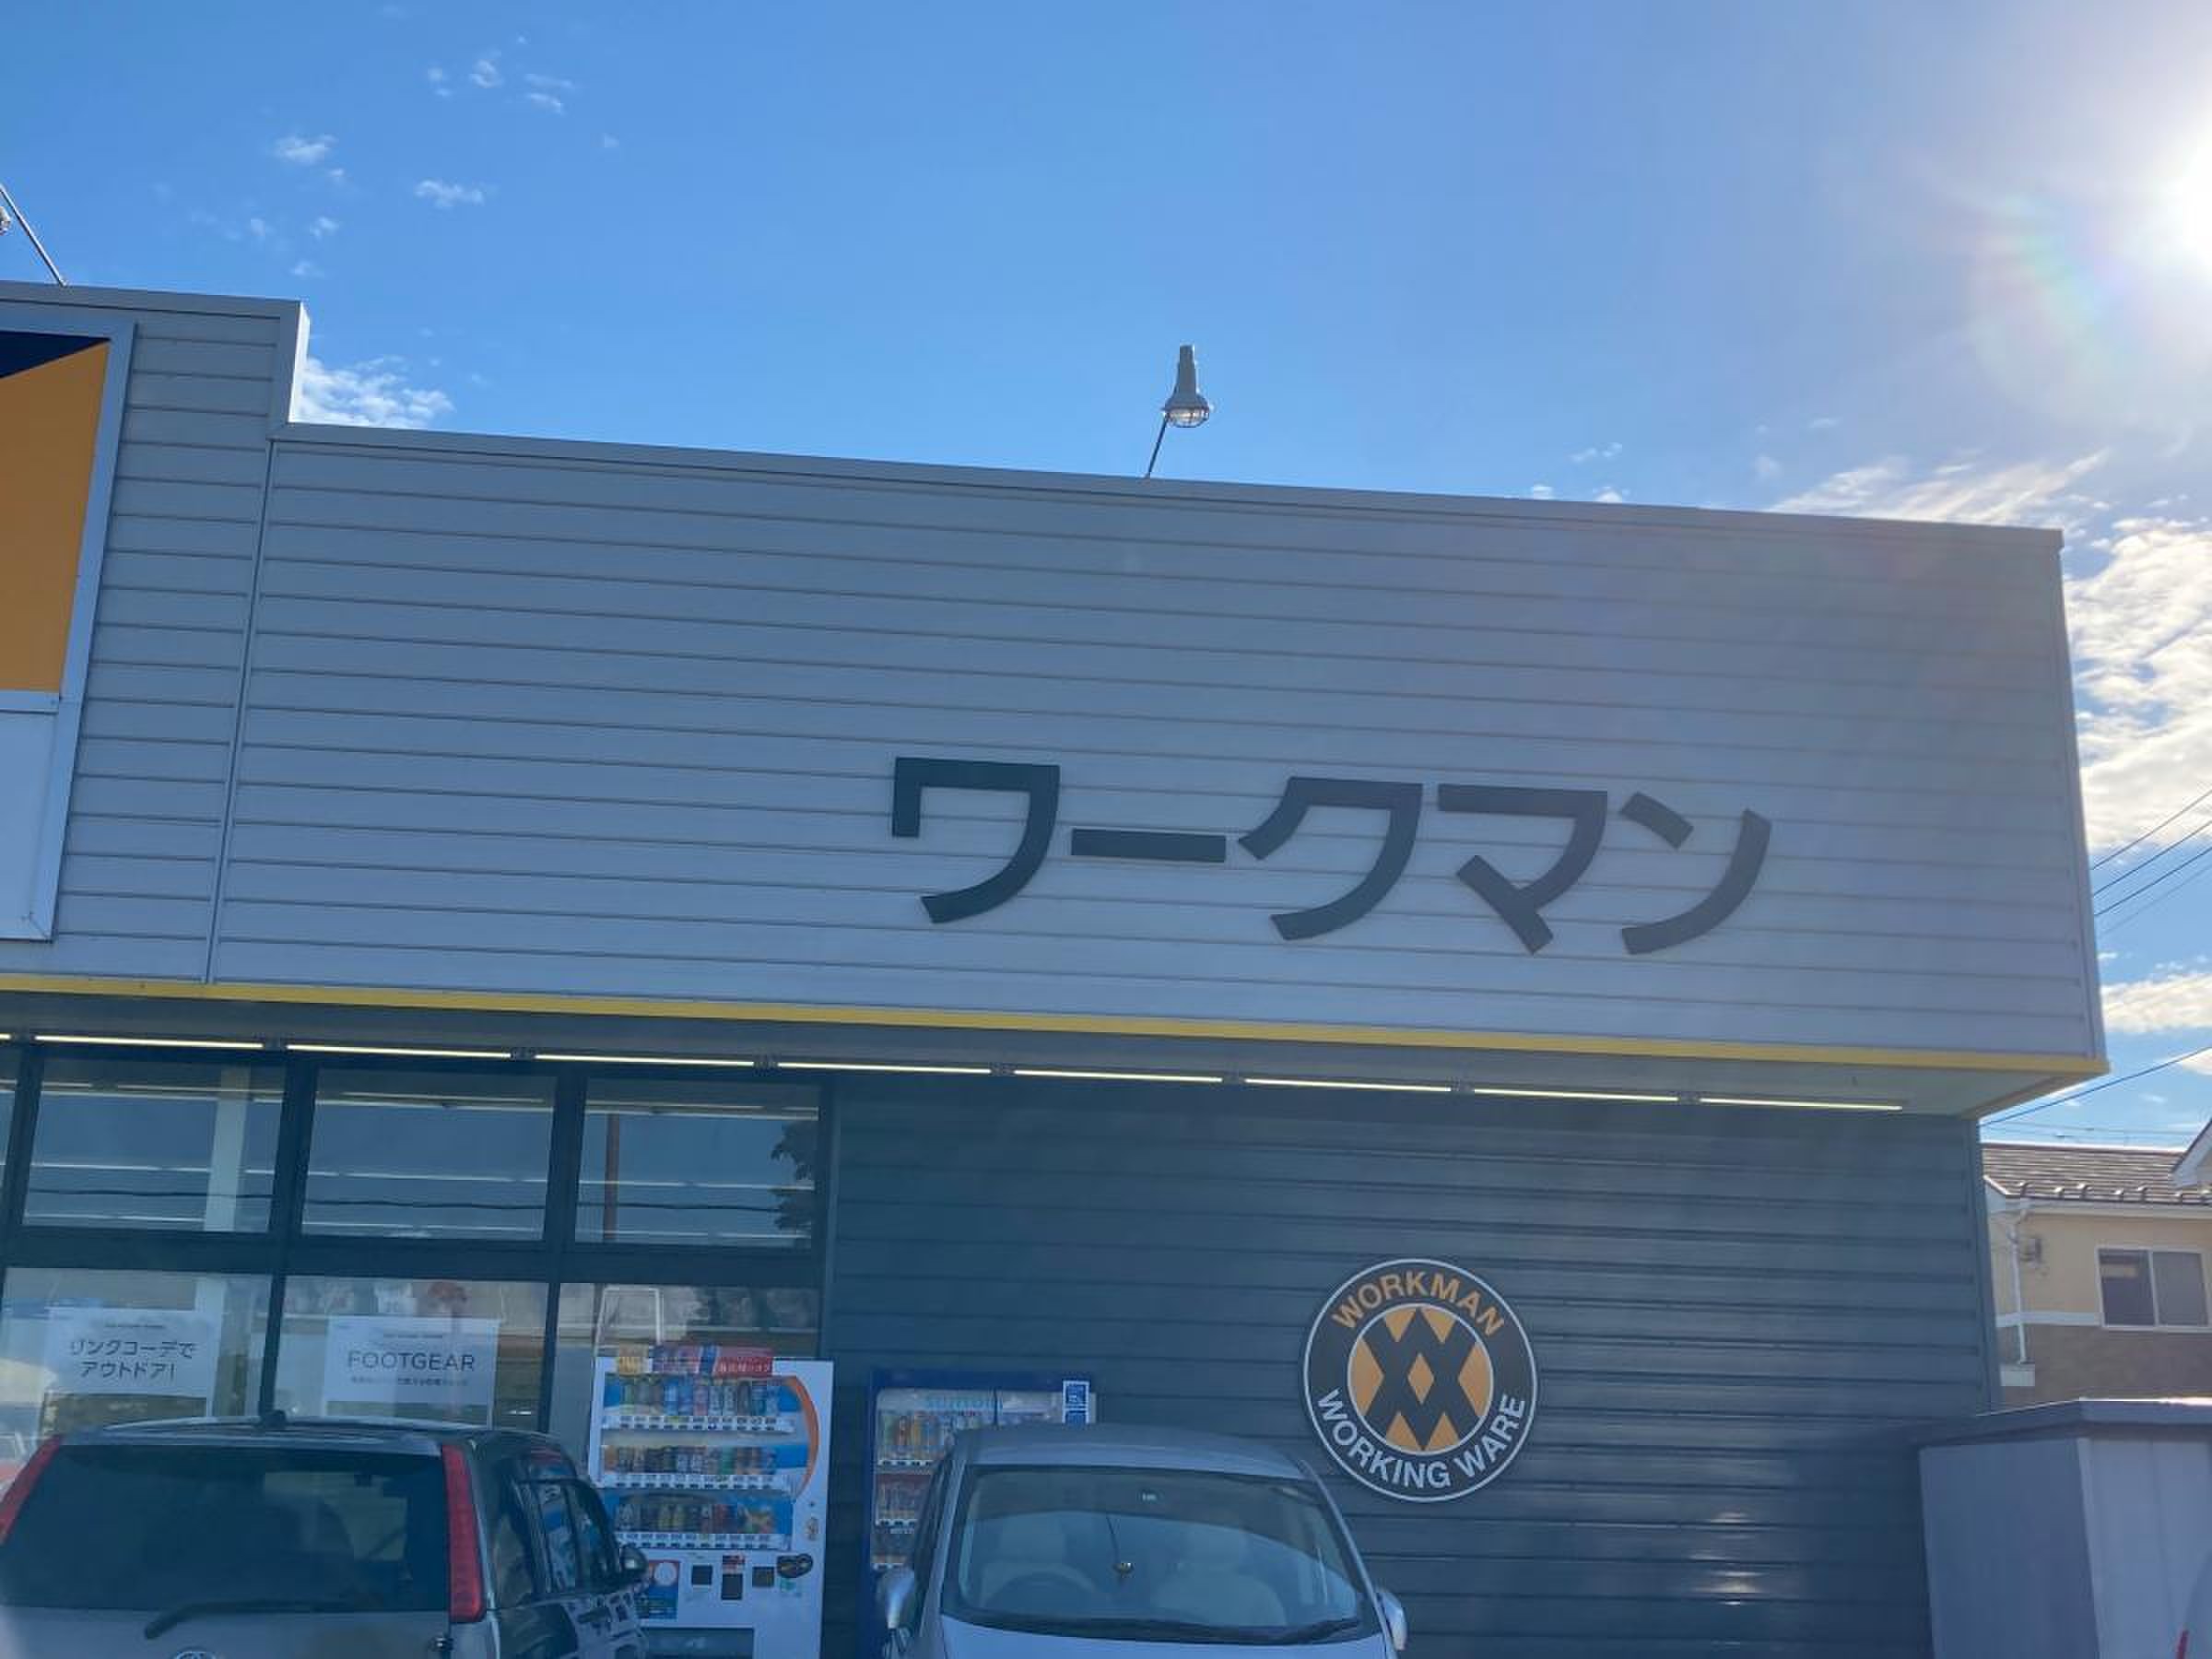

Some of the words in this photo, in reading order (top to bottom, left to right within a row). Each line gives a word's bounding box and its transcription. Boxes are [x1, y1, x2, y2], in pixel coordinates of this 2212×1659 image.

[891, 757, 1771, 956] ワークマン
[1332, 1270, 1505, 1337] WORKMAN
[347, 1350, 476, 1372] FOOTGEAR
[1317, 1388, 1452, 1489] WORKING
[1454, 1393, 1526, 1478] WARE
